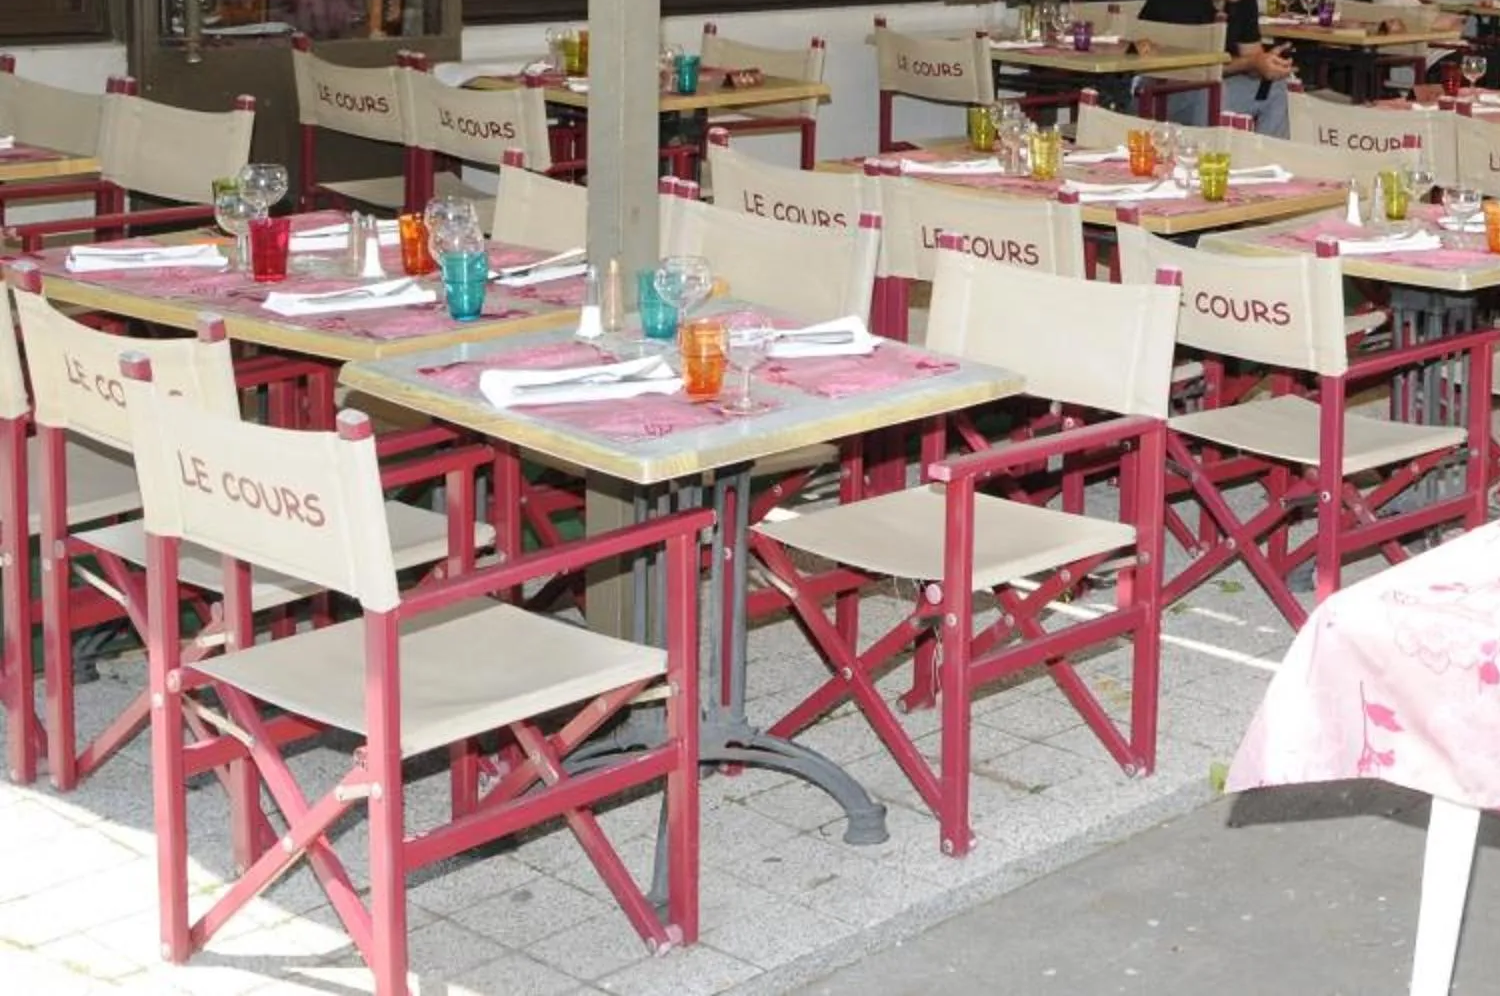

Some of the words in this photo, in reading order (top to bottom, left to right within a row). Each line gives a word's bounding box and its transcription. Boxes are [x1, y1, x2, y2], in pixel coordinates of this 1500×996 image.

[913, 61, 963, 77] COURS
[335, 92, 390, 114] COURS
[457, 117, 516, 140] COURS
[1318, 125, 1339, 147] LE
[1348, 134, 1401, 153] COUR
[744, 190, 765, 217] LE
[773, 202, 848, 228] COURS
[1195, 291, 1291, 326] COURS
[65, 352, 92, 393] LE
[177, 451, 213, 494] LE
[221, 471, 326, 528] COURS
